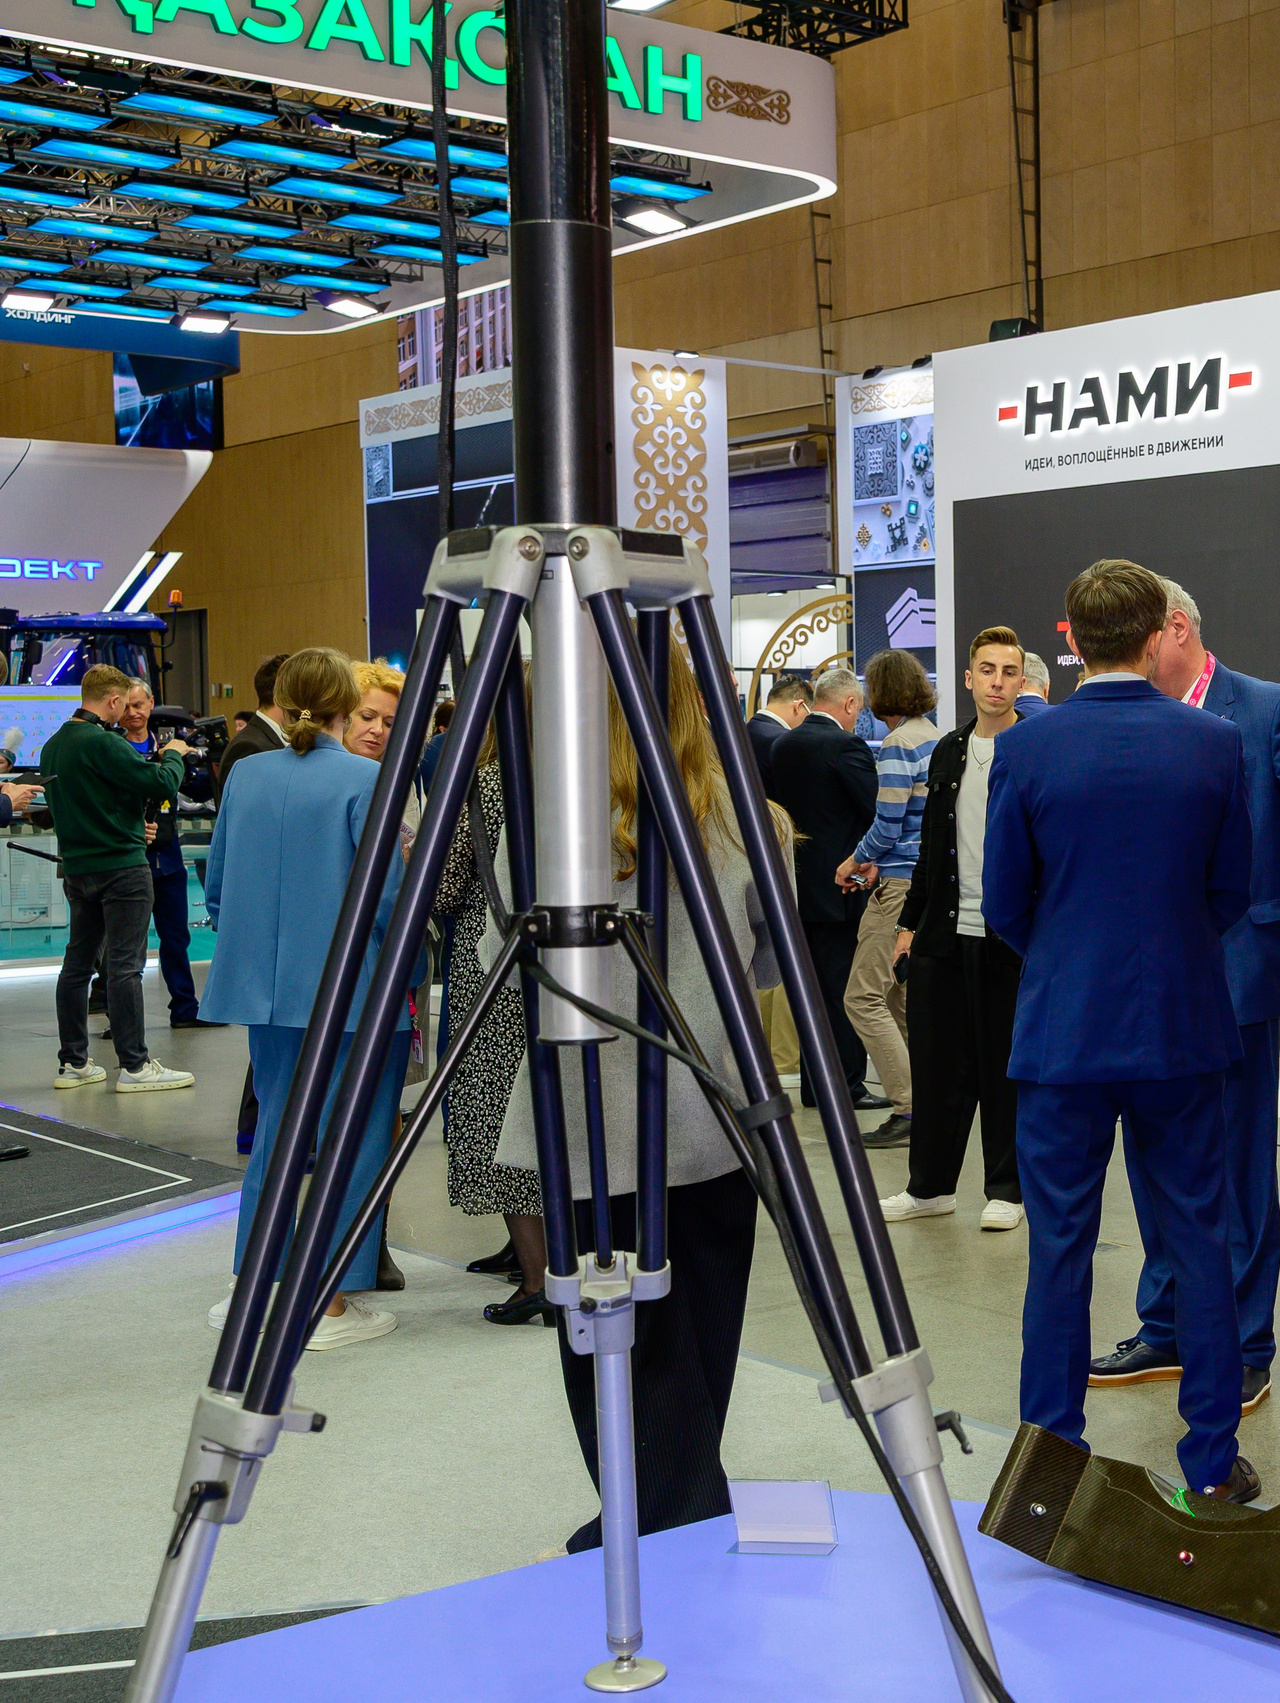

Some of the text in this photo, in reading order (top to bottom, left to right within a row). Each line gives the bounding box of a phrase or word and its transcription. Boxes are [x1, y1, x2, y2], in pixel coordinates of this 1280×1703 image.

[5, 308, 76, 324] ХОЛДИНГ
[1024, 435, 1225, 471] ИДЕИ, ВОПЛОЩЁННЫЕ В ДВИЖЕНИИ
